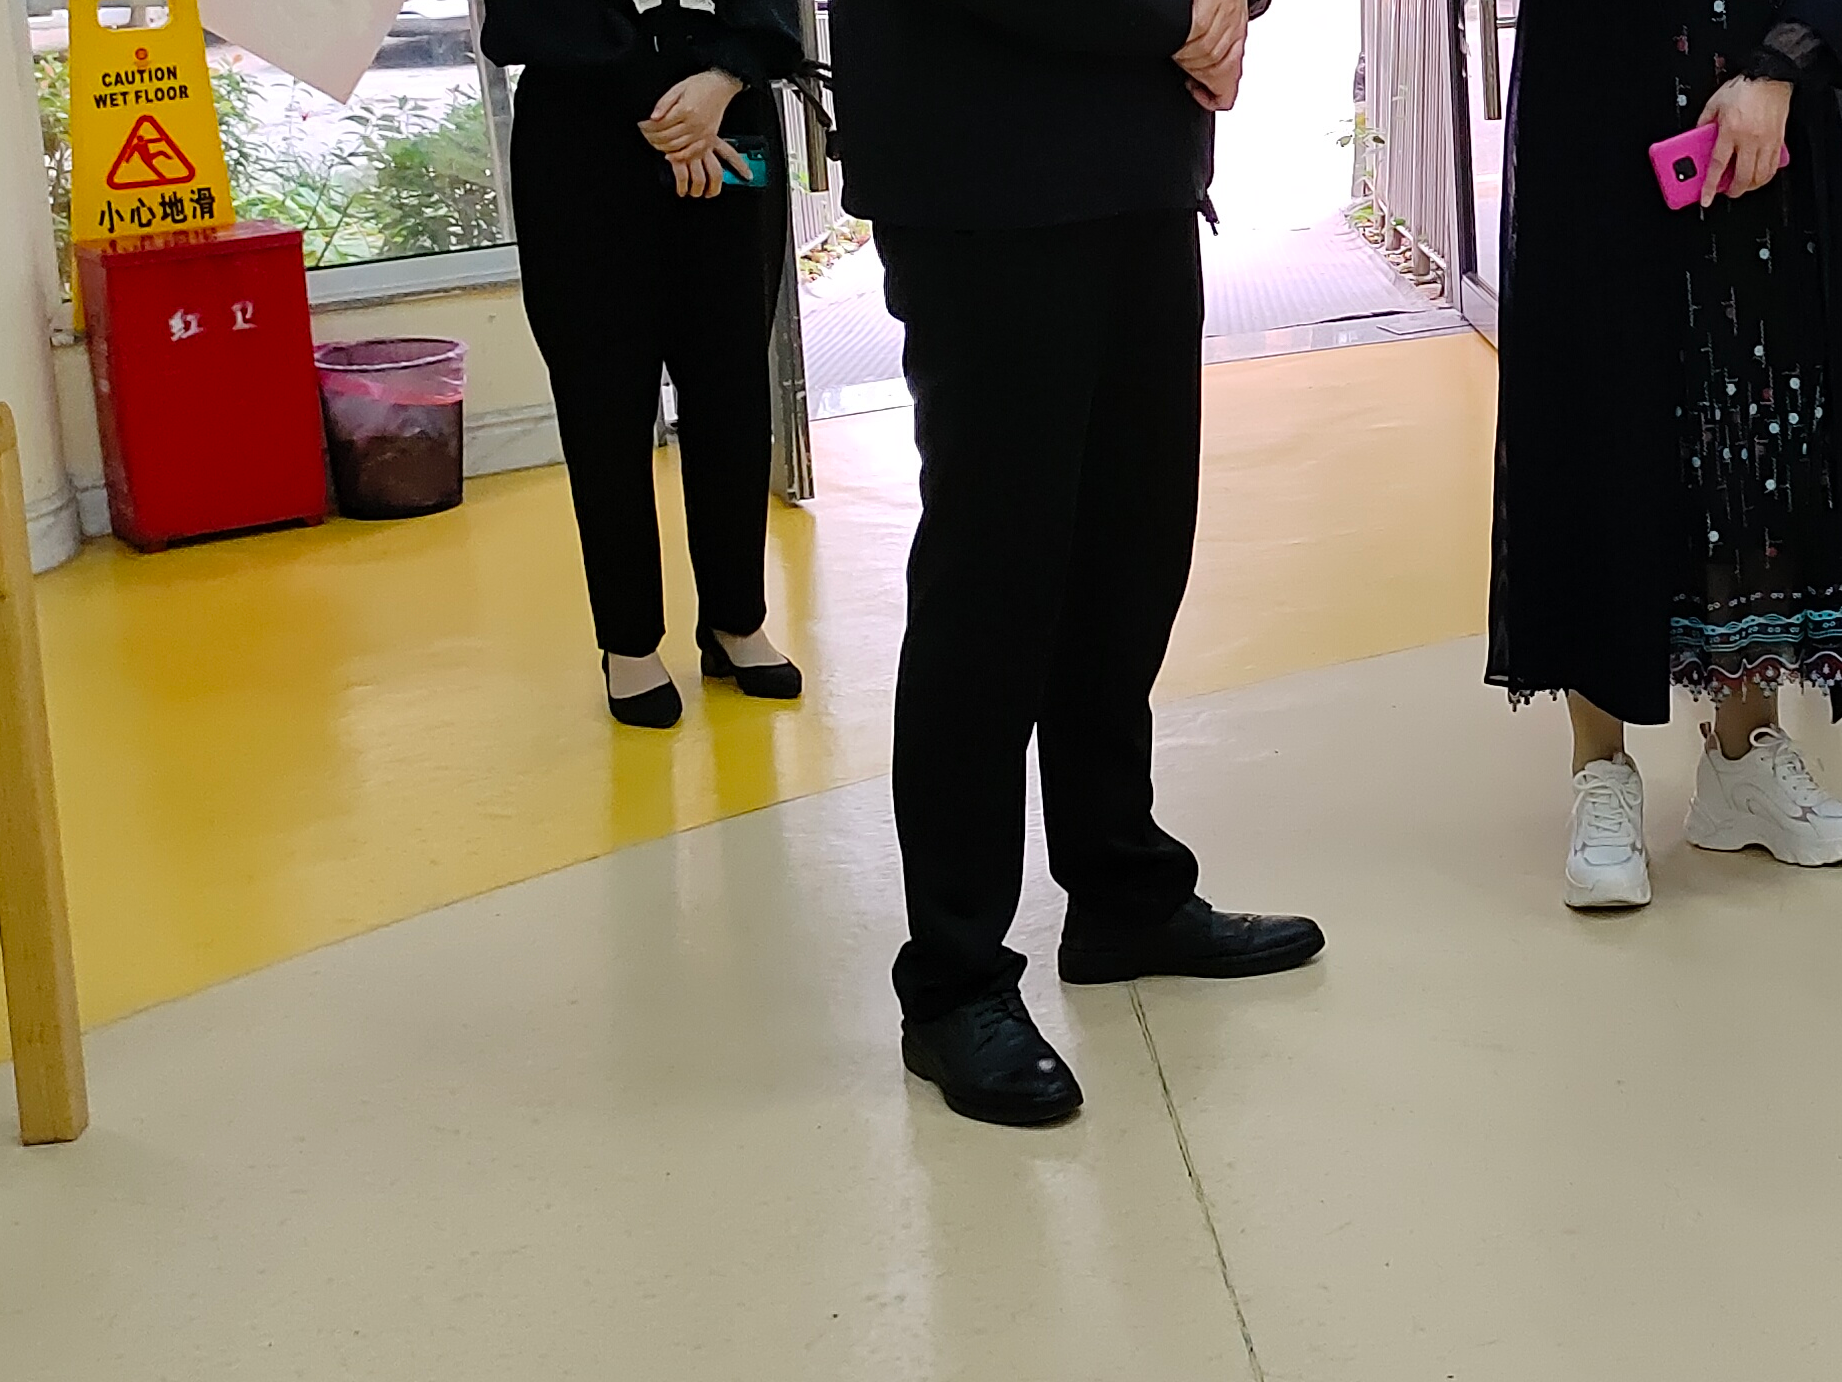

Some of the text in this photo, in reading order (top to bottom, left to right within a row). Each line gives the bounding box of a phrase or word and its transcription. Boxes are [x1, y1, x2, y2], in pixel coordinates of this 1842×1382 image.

[101, 65, 178, 88] CAUTION
[93, 85, 189, 109] WET FLOOR
[98, 186, 216, 234] 小心地滑
